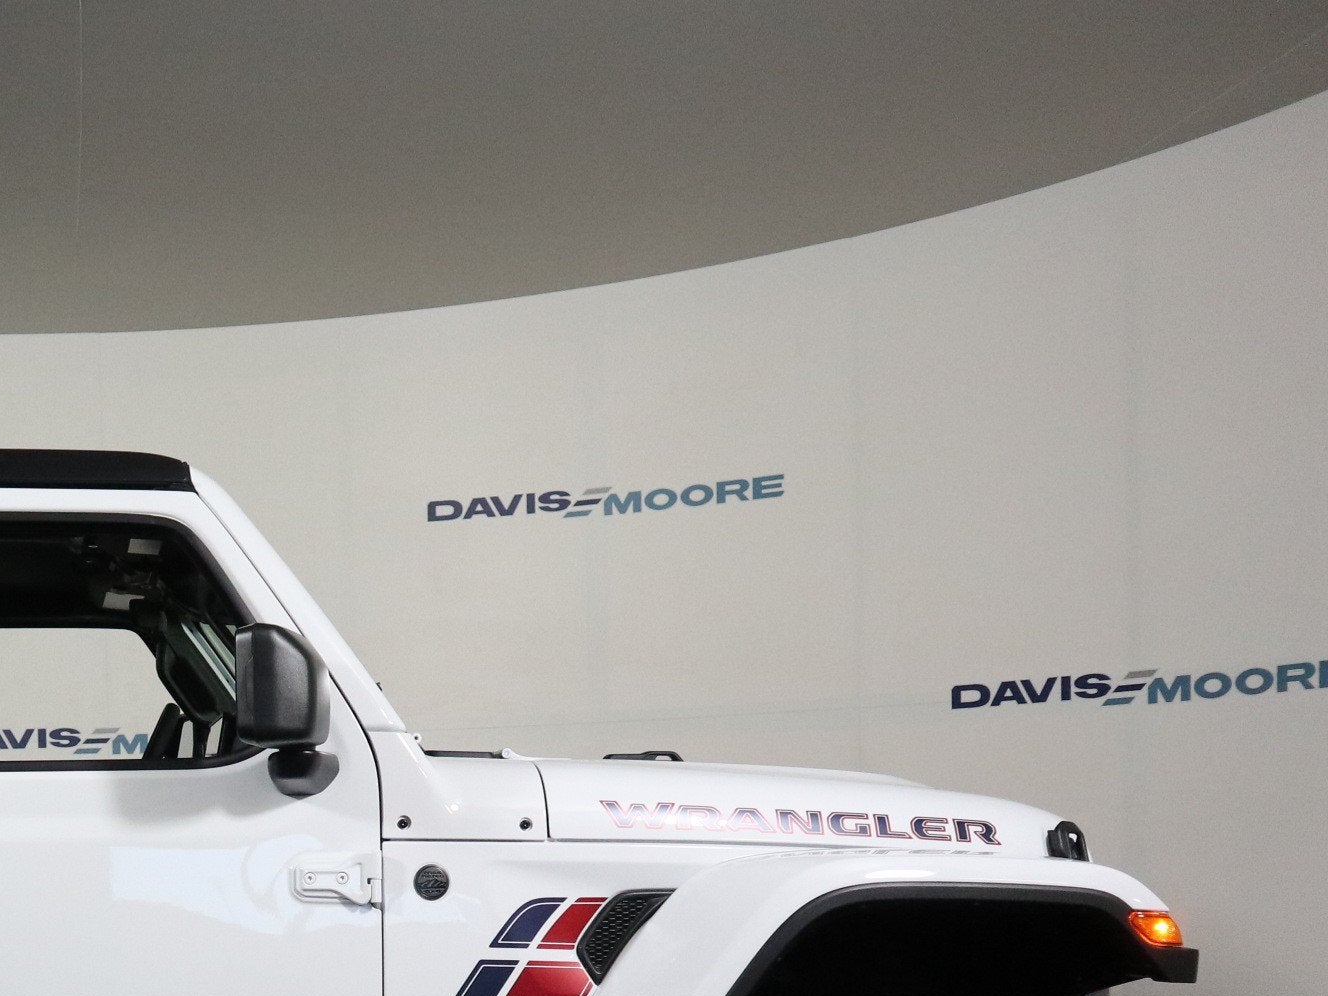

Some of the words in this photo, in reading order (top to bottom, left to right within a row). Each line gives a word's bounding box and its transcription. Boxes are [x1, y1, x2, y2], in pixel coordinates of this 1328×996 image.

[427, 490, 571, 522] DAVIS
[603, 474, 785, 516] MOORE
[951, 673, 1112, 709] DAVIS
[599, 799, 1002, 846] WRANGLER
